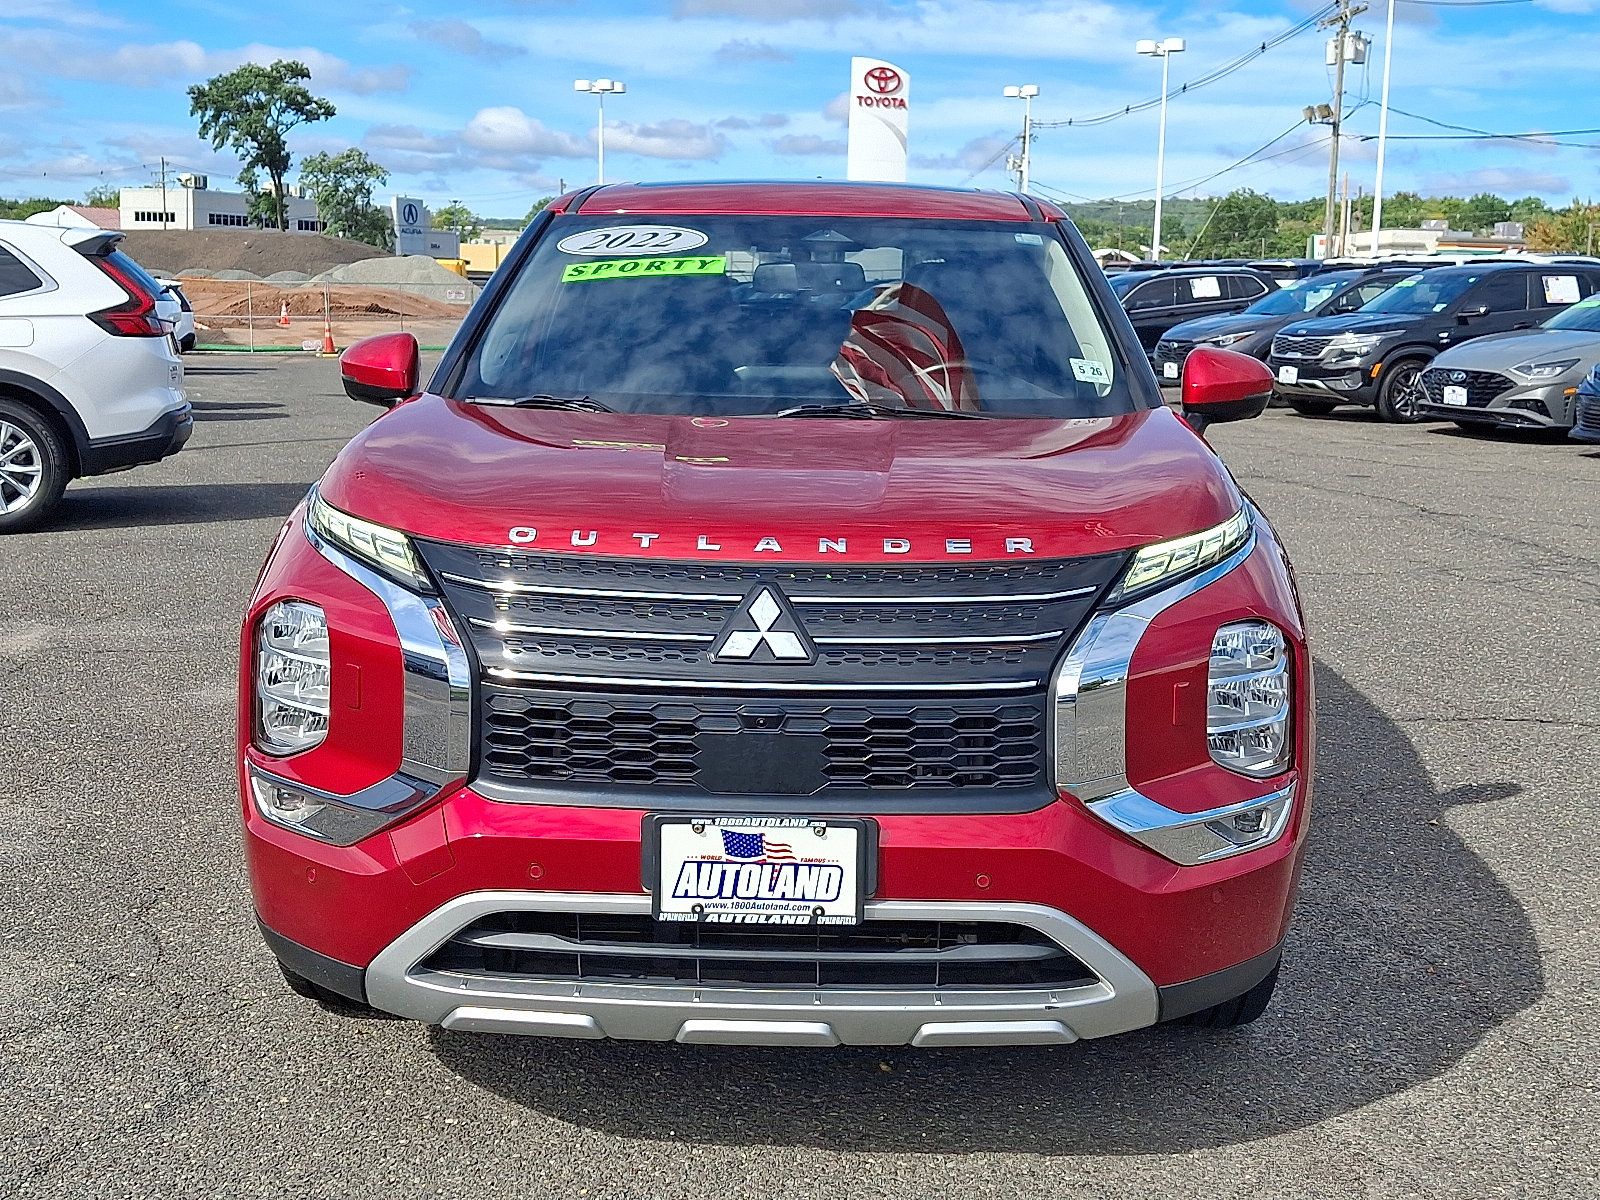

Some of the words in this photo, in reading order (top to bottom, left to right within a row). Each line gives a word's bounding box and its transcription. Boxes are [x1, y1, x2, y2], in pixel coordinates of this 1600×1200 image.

[856, 95, 909, 111] TOYOTA
[577, 232, 683, 251] 2022
[567, 259, 723, 277] SPORTY
[1078, 365, 1086, 374] 5
[1090, 366, 1103, 376] 26
[508, 526, 1035, 554] OUTLANDER
[671, 861, 844, 902] AUTOLAND
[704, 901, 811, 912] www.1800Autoland.com
[705, 913, 811, 925] AUTOLAND
